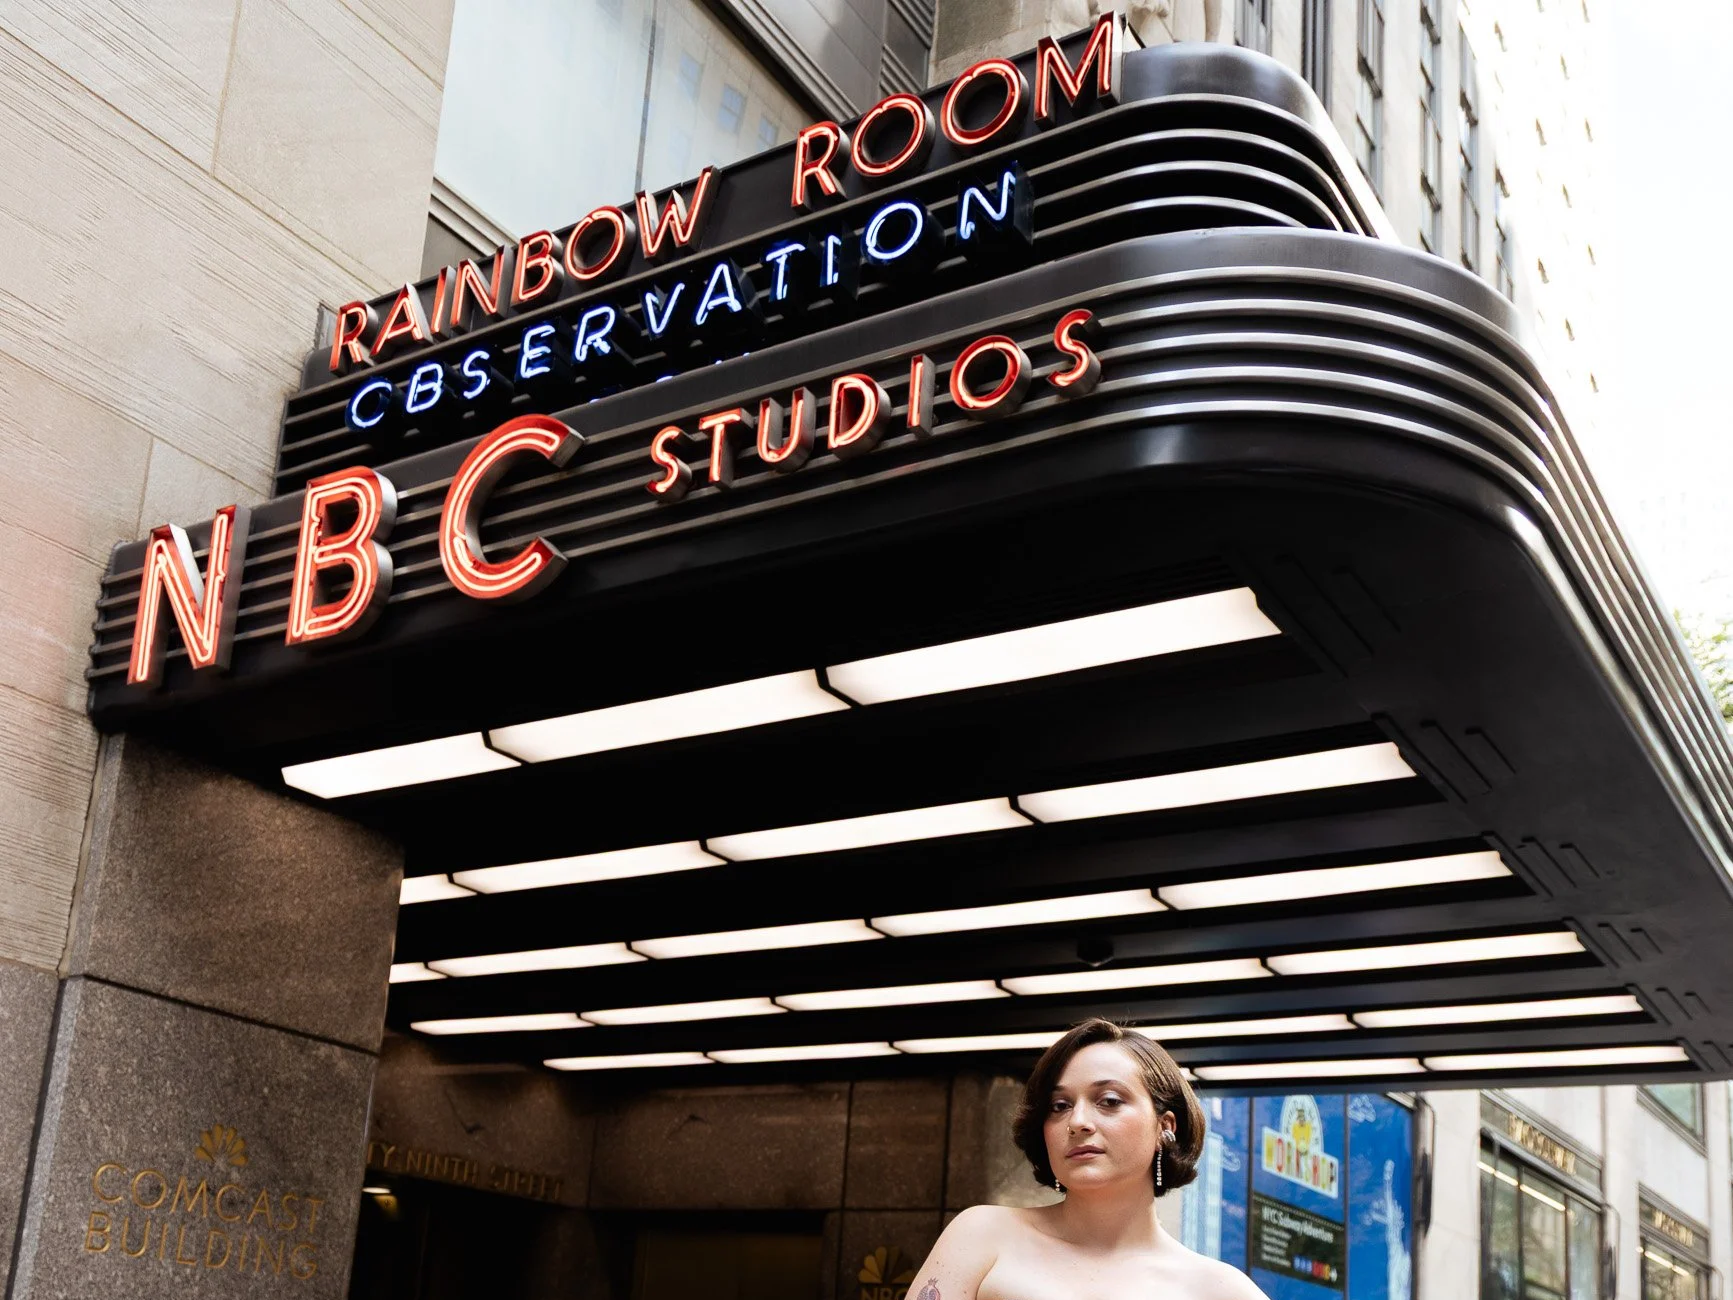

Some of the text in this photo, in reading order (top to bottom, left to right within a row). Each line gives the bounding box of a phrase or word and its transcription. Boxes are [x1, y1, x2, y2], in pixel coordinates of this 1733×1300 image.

[330, 10, 1120, 374] RAINBOW ROOM
[127, 308, 1098, 686] NBC STUDIOS
[92, 1163, 324, 1234] COMCAST
[406, 1149, 479, 1184] NINTH
[84, 1211, 318, 1280] BUILDING
